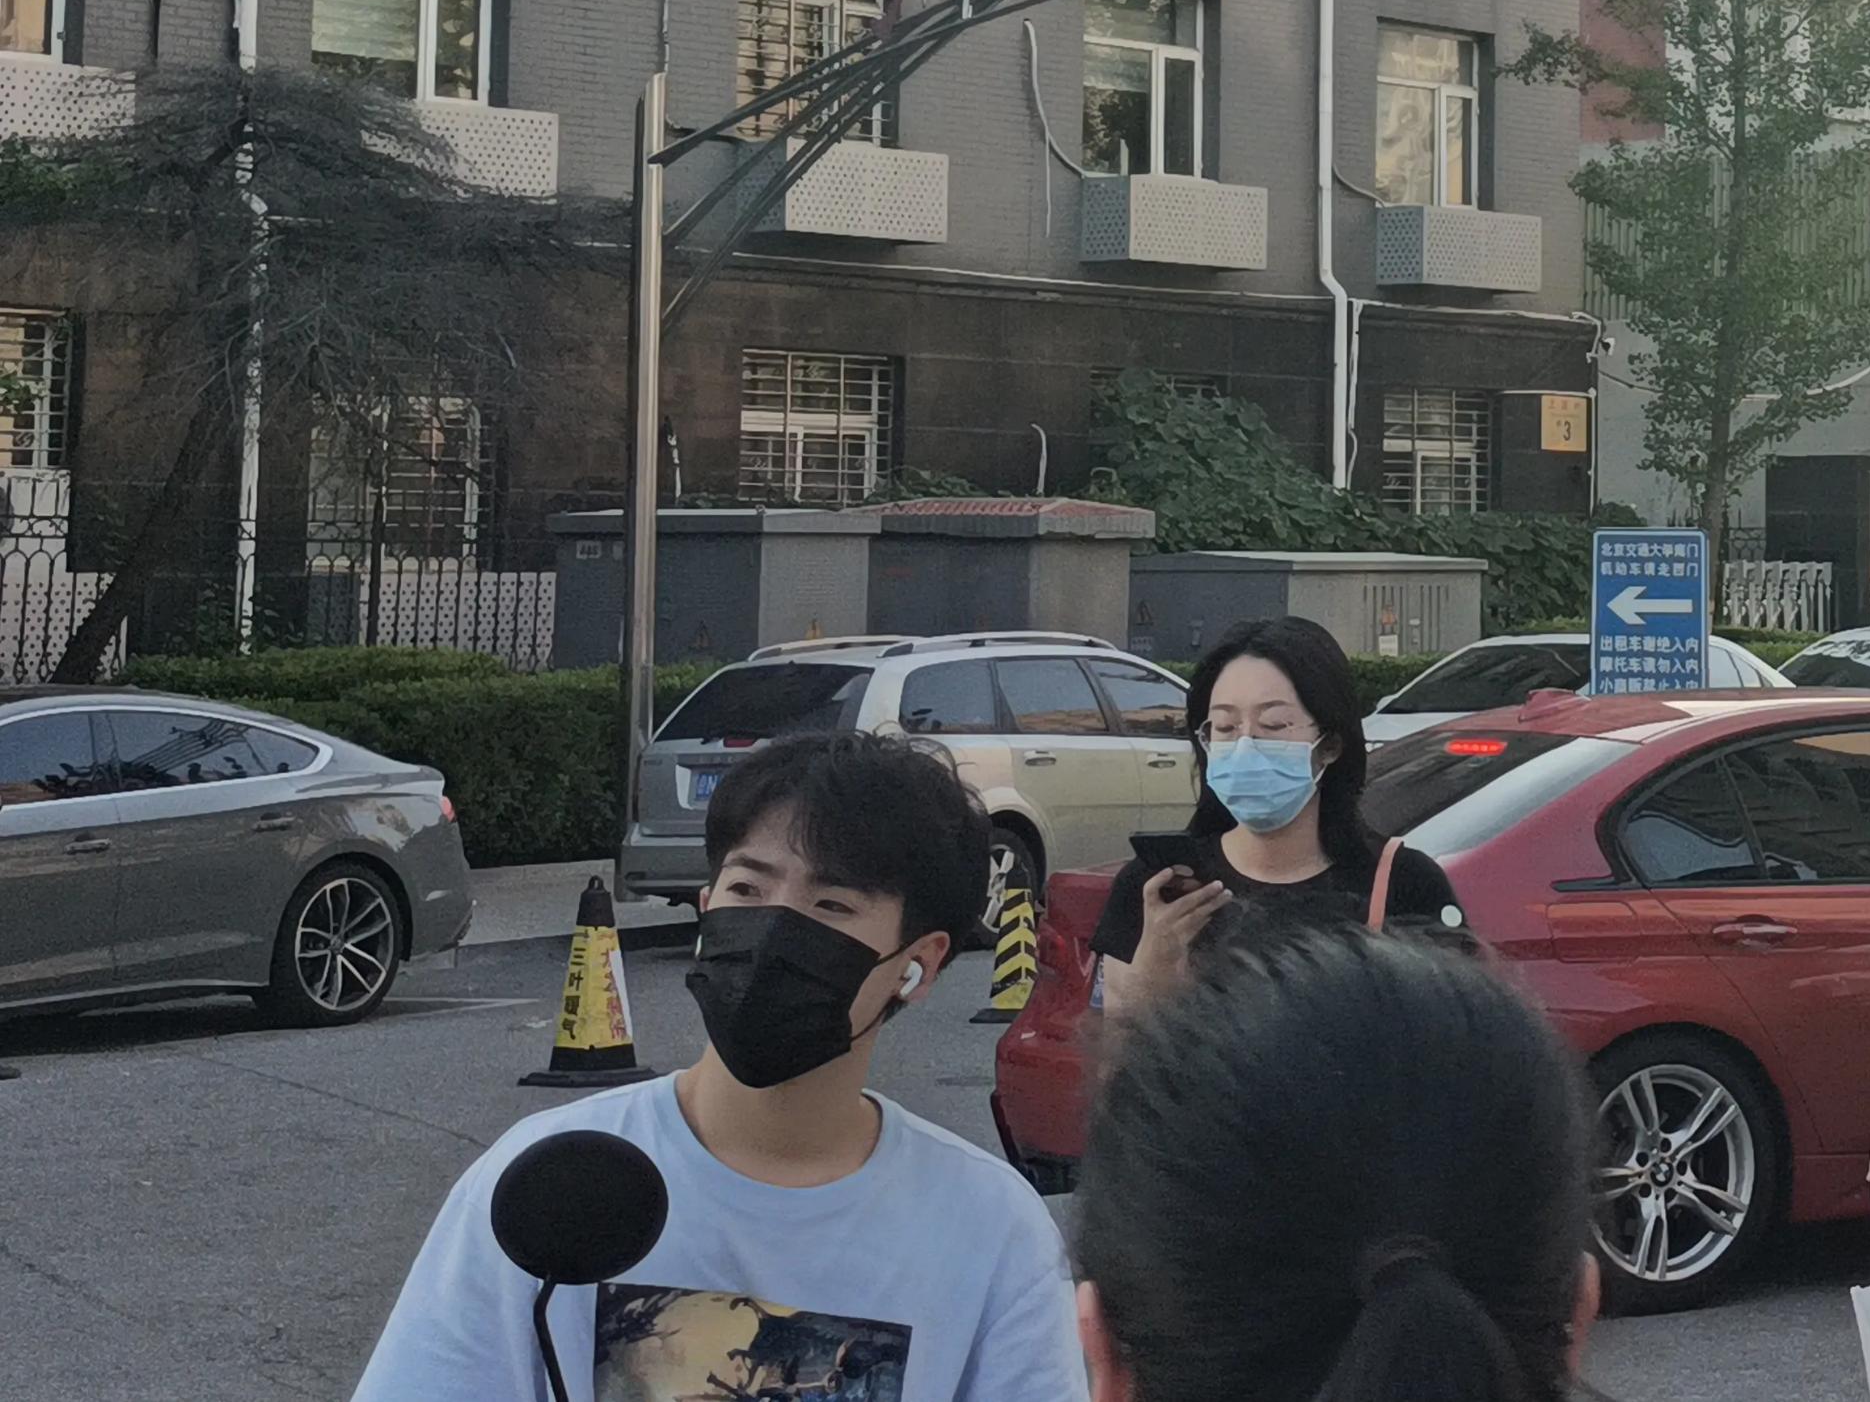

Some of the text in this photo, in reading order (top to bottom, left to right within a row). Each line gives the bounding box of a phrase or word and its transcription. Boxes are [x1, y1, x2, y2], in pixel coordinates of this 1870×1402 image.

[1600, 635, 1699, 654] 出租车谢绝入内
[1600, 656, 1699, 674] 摩托车请勿入内
